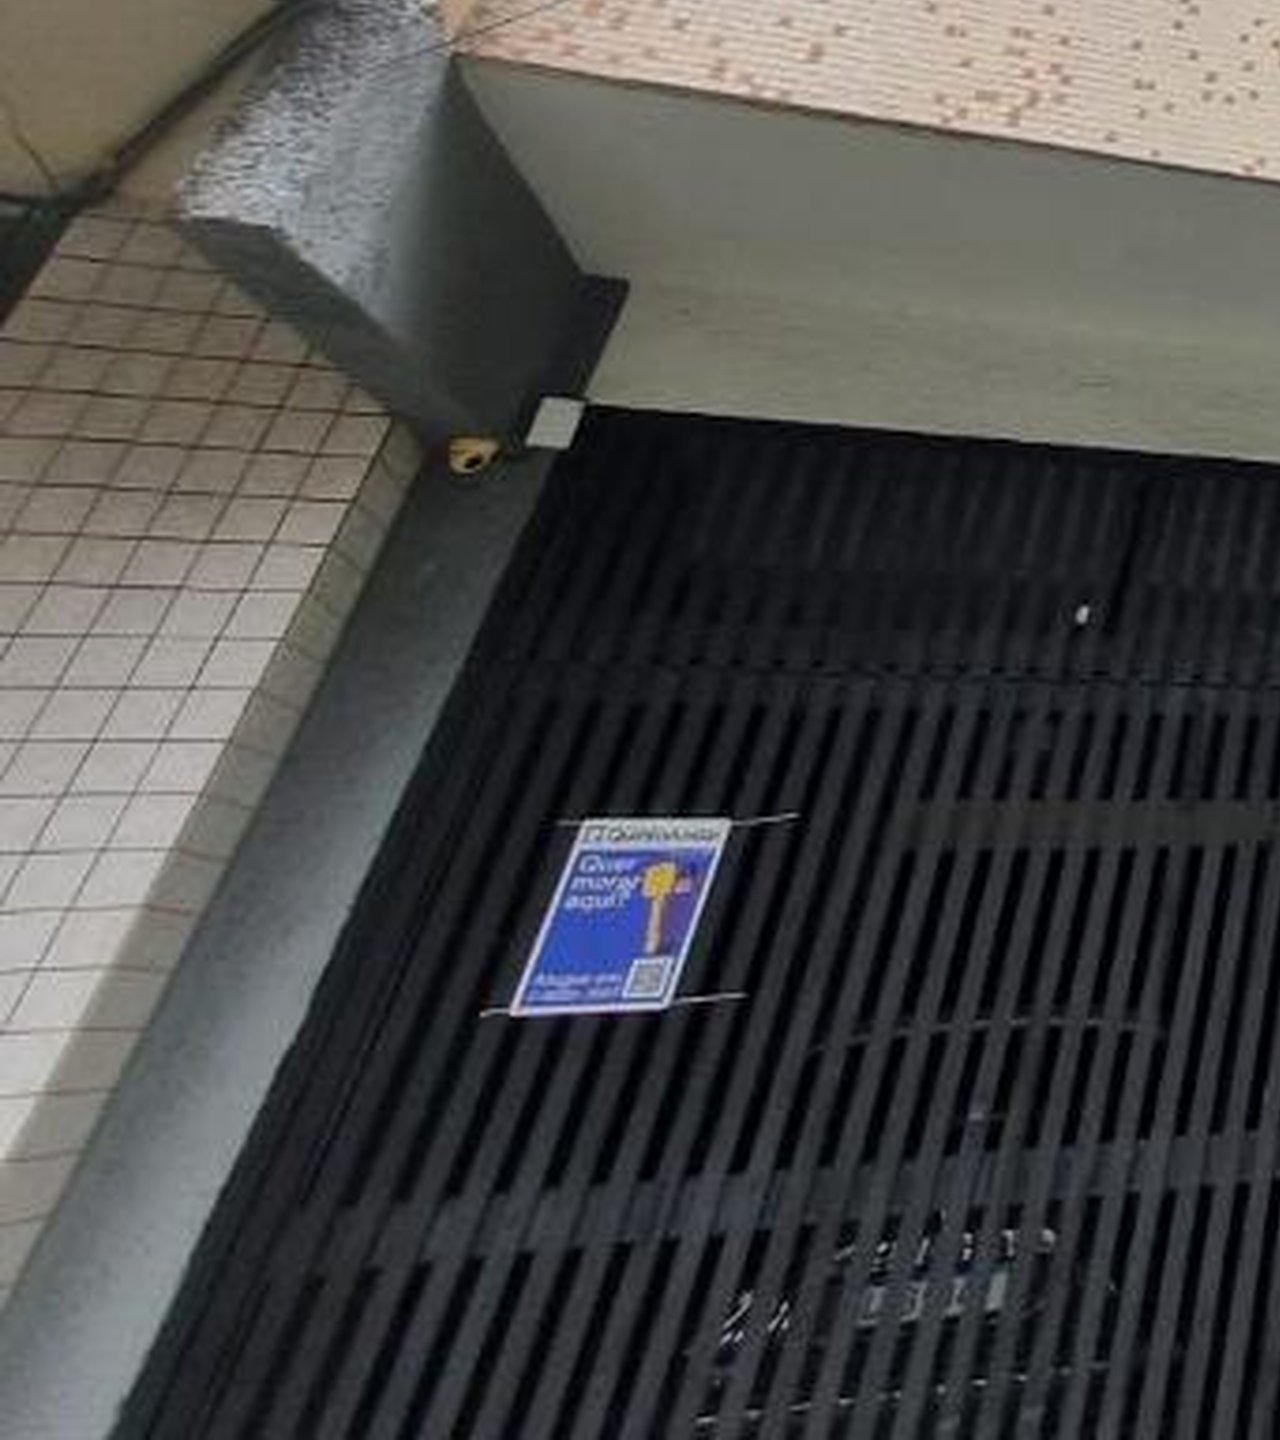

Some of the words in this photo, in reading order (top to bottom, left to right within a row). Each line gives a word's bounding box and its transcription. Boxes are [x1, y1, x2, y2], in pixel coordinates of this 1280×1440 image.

[578, 854, 637, 873] Quer
[568, 875, 641, 891] morar
[563, 889, 631, 911] aqui?
